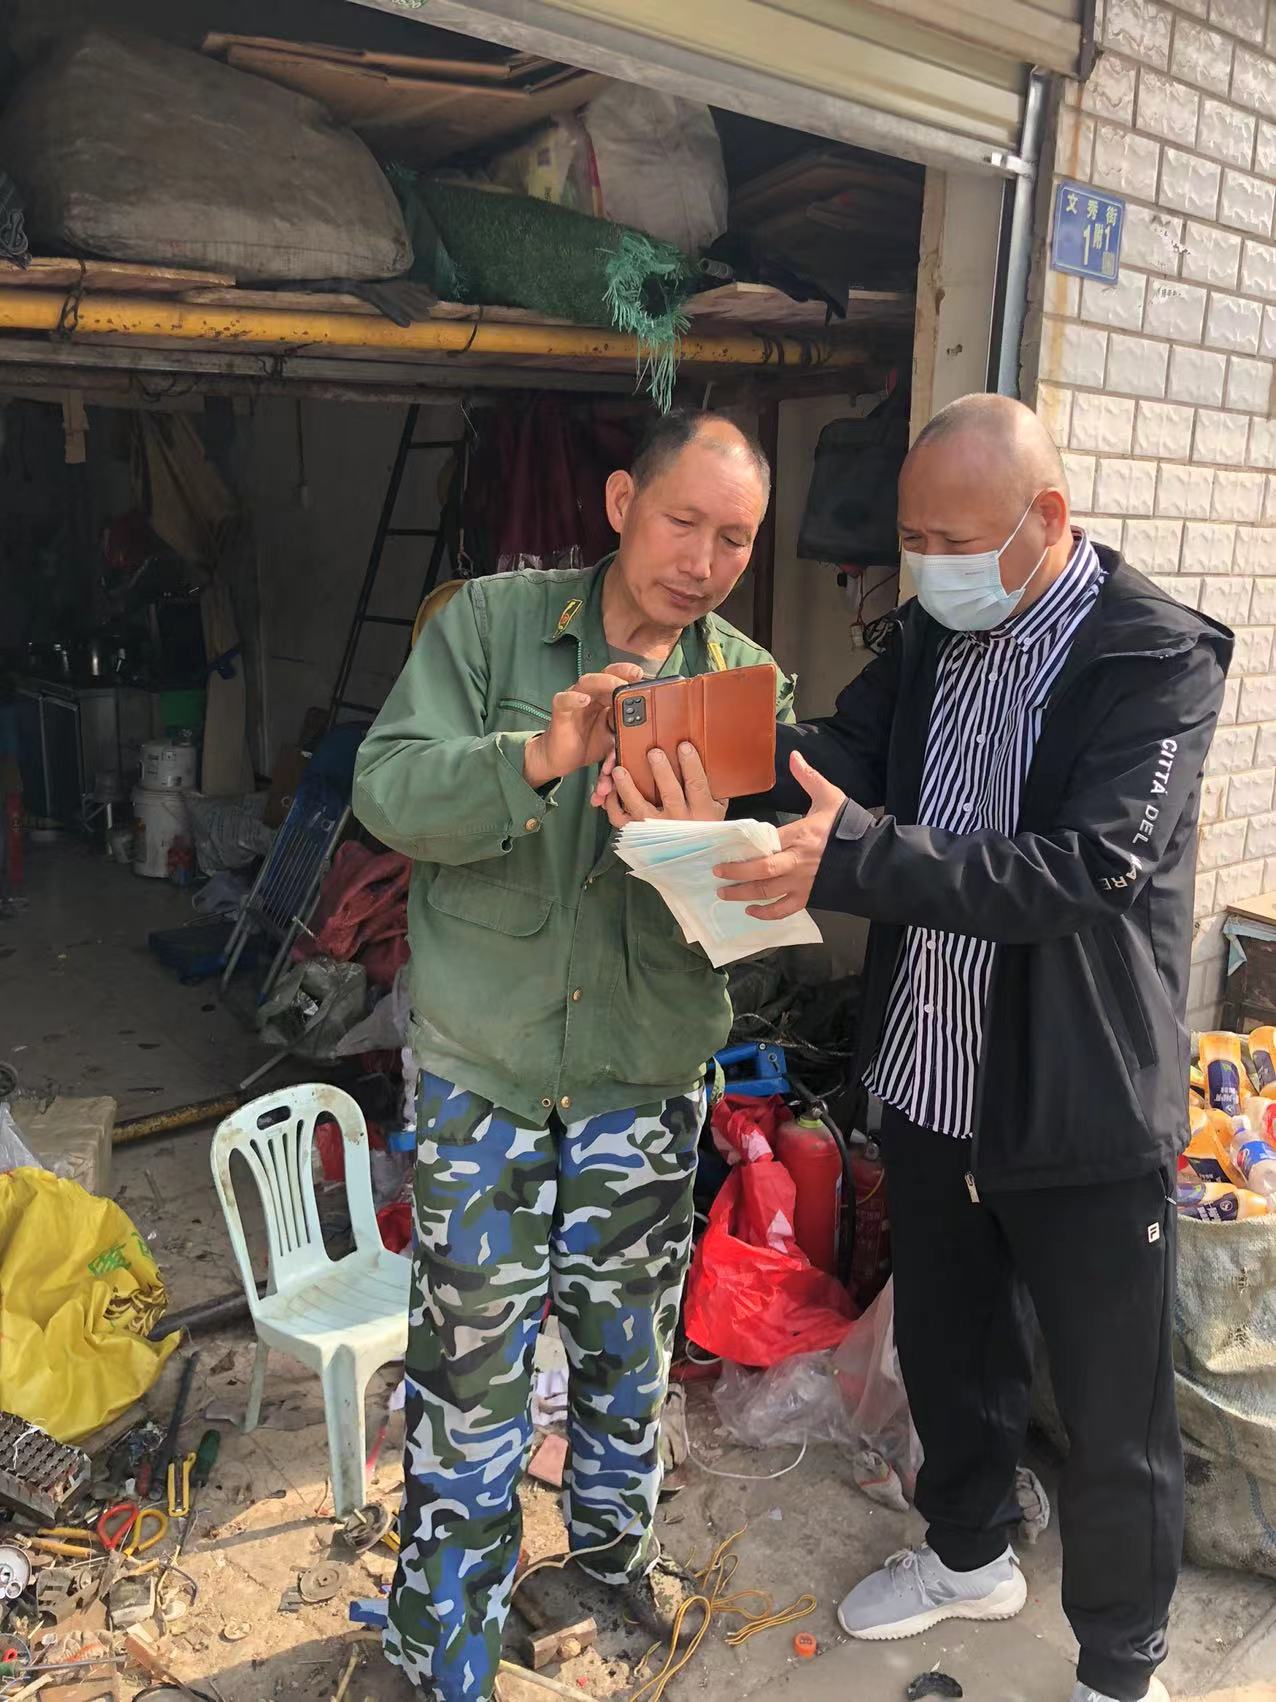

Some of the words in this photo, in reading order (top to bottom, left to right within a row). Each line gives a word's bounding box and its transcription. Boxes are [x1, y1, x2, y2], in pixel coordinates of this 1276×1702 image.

[1066, 193, 1118, 226] 文秀街
[1132, 804, 1159, 844] DEL
